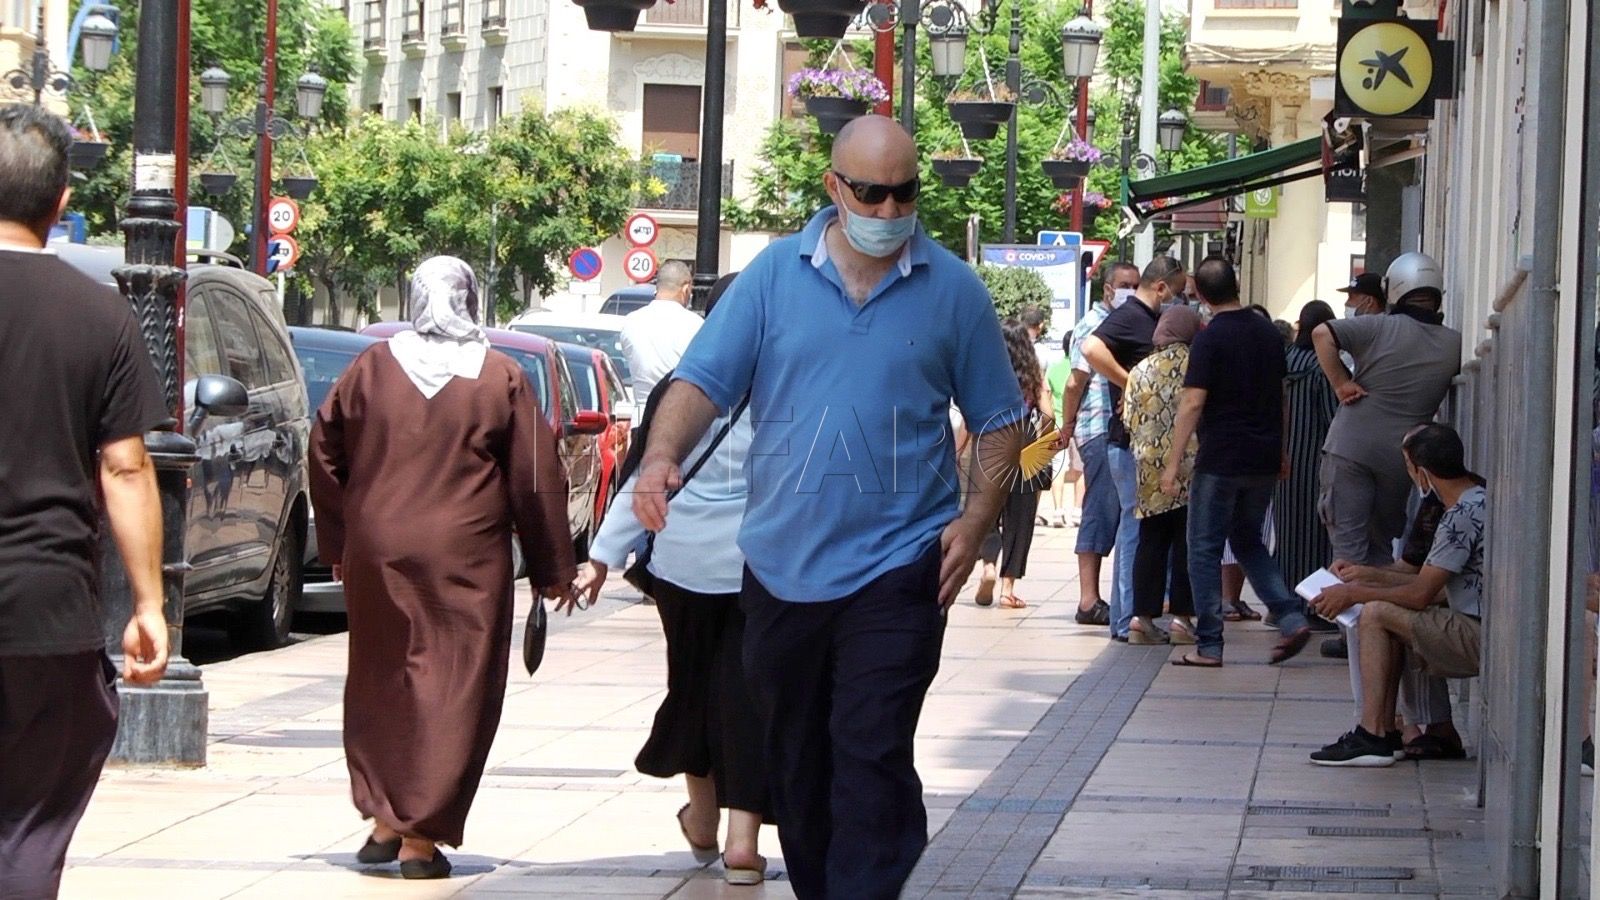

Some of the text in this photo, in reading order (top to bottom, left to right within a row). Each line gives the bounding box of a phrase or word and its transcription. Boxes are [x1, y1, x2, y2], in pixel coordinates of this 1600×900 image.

[273, 210, 291, 222] 20
[1018, 252, 1056, 261] COVID-19
[631, 257, 650, 272] 20
